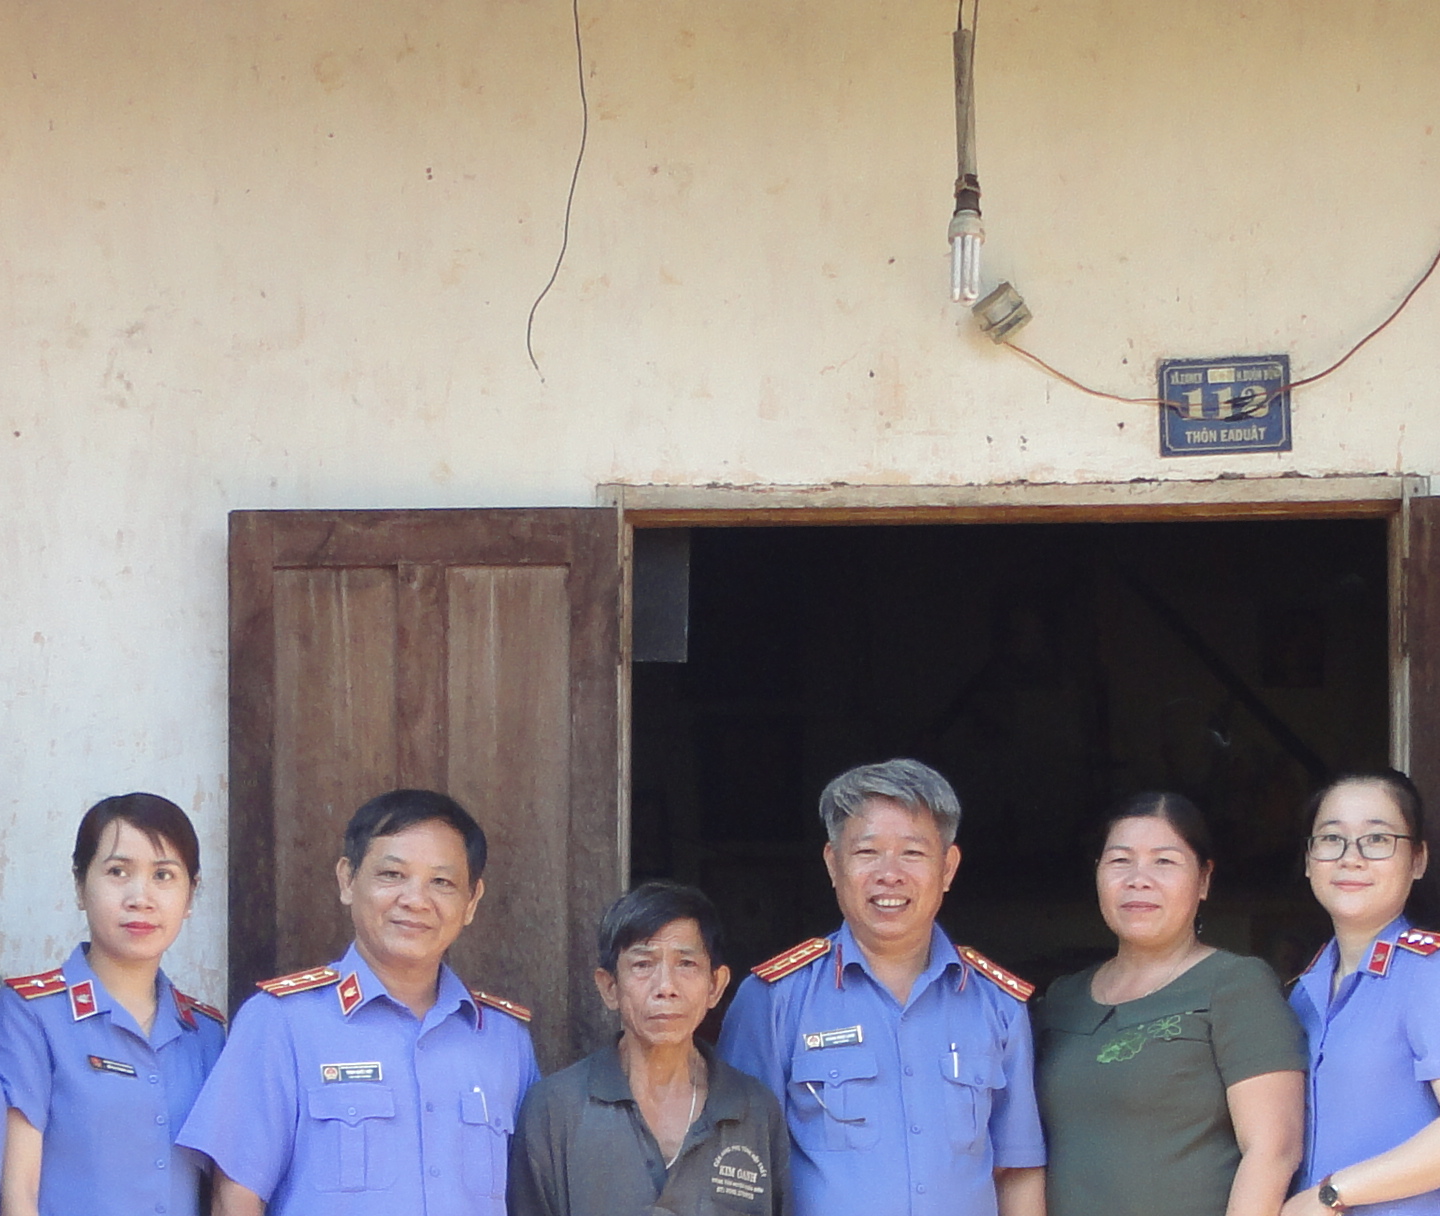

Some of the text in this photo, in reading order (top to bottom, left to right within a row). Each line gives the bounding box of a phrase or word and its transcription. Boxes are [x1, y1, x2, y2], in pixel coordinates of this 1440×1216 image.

[1185, 427, 1217, 444] THÔN
[719, 1165, 757, 1183] KIM OANH
